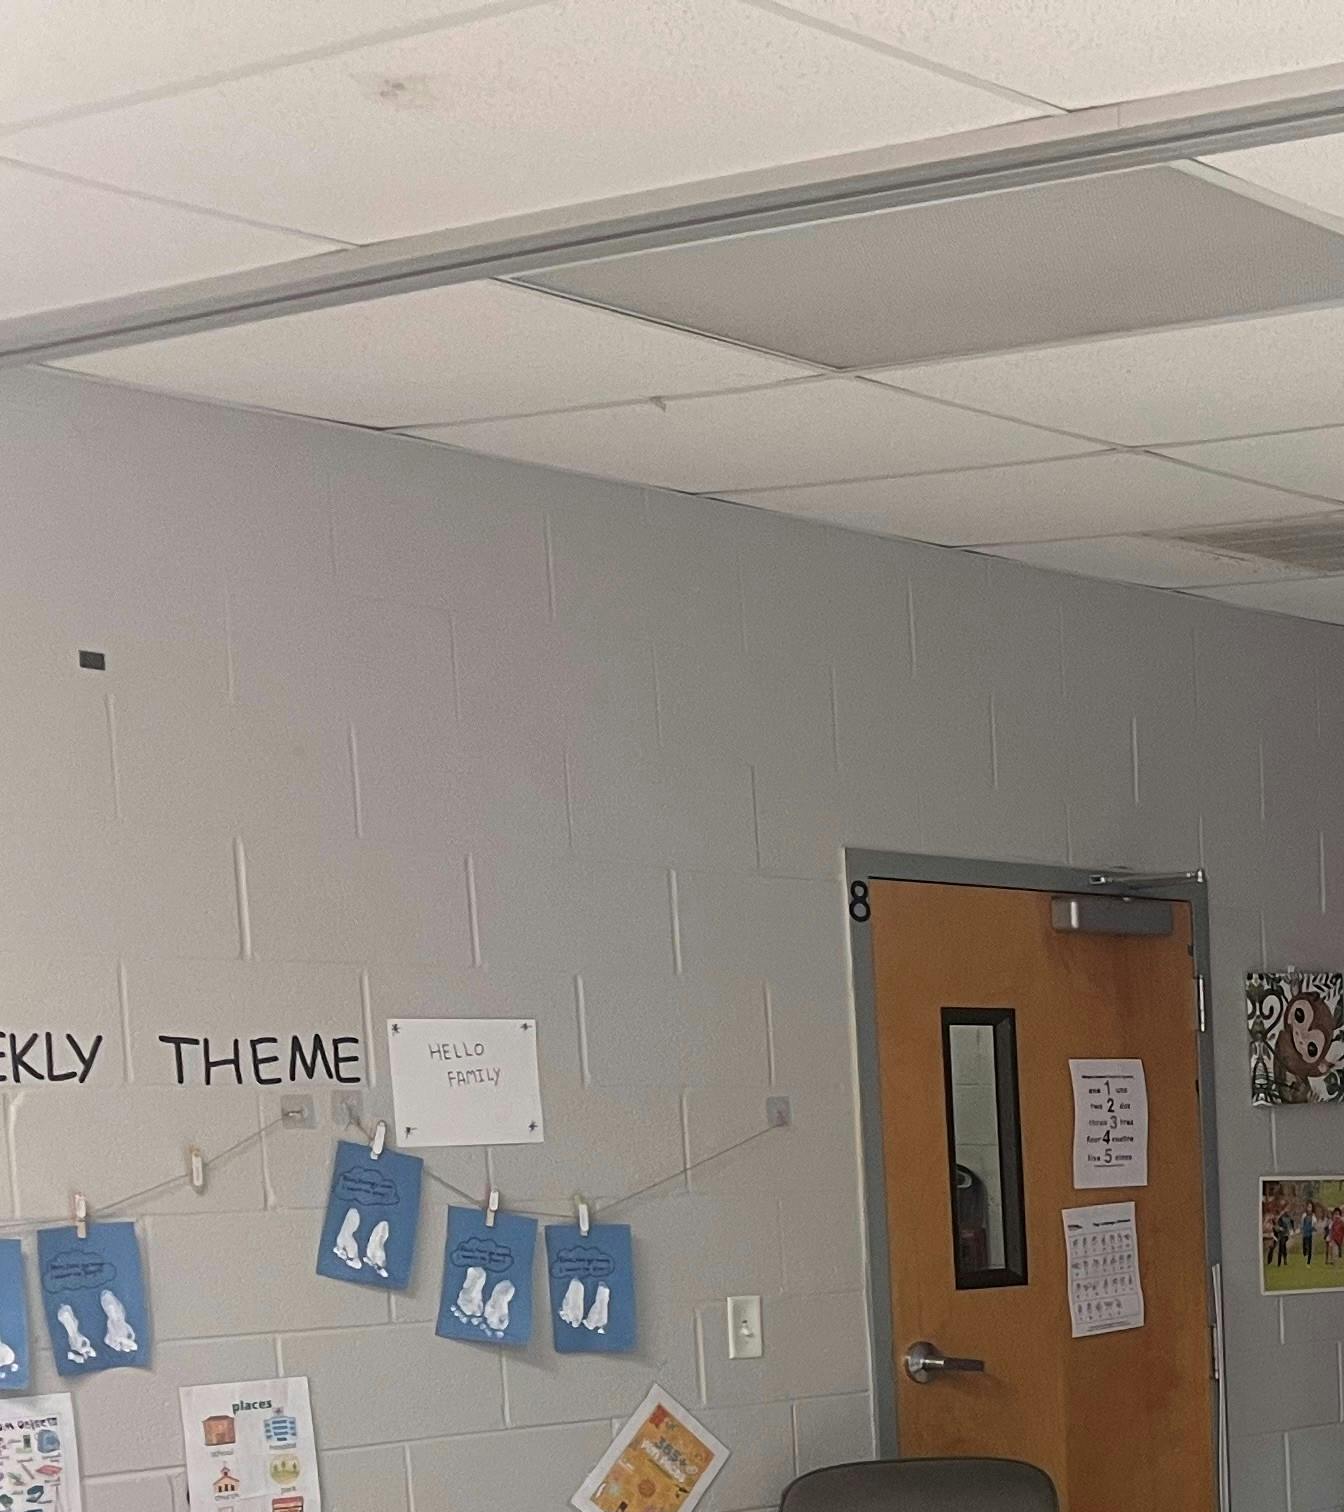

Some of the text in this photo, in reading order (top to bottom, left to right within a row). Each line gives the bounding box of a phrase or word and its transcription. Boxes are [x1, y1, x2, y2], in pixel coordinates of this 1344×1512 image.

[849, 880, 871, 922] 8
[428, 1041, 485, 1061] HELLO
[158, 1034, 361, 1086] THEME
[447, 1067, 501, 1087] FAMILY
[1107, 1098, 1114, 1113] 2
[1110, 1115, 1117, 1129] 3
[1102, 1130, 1110, 1144] 4
[1104, 1149, 1112, 1163] 5
[232, 1400, 273, 1415] places
